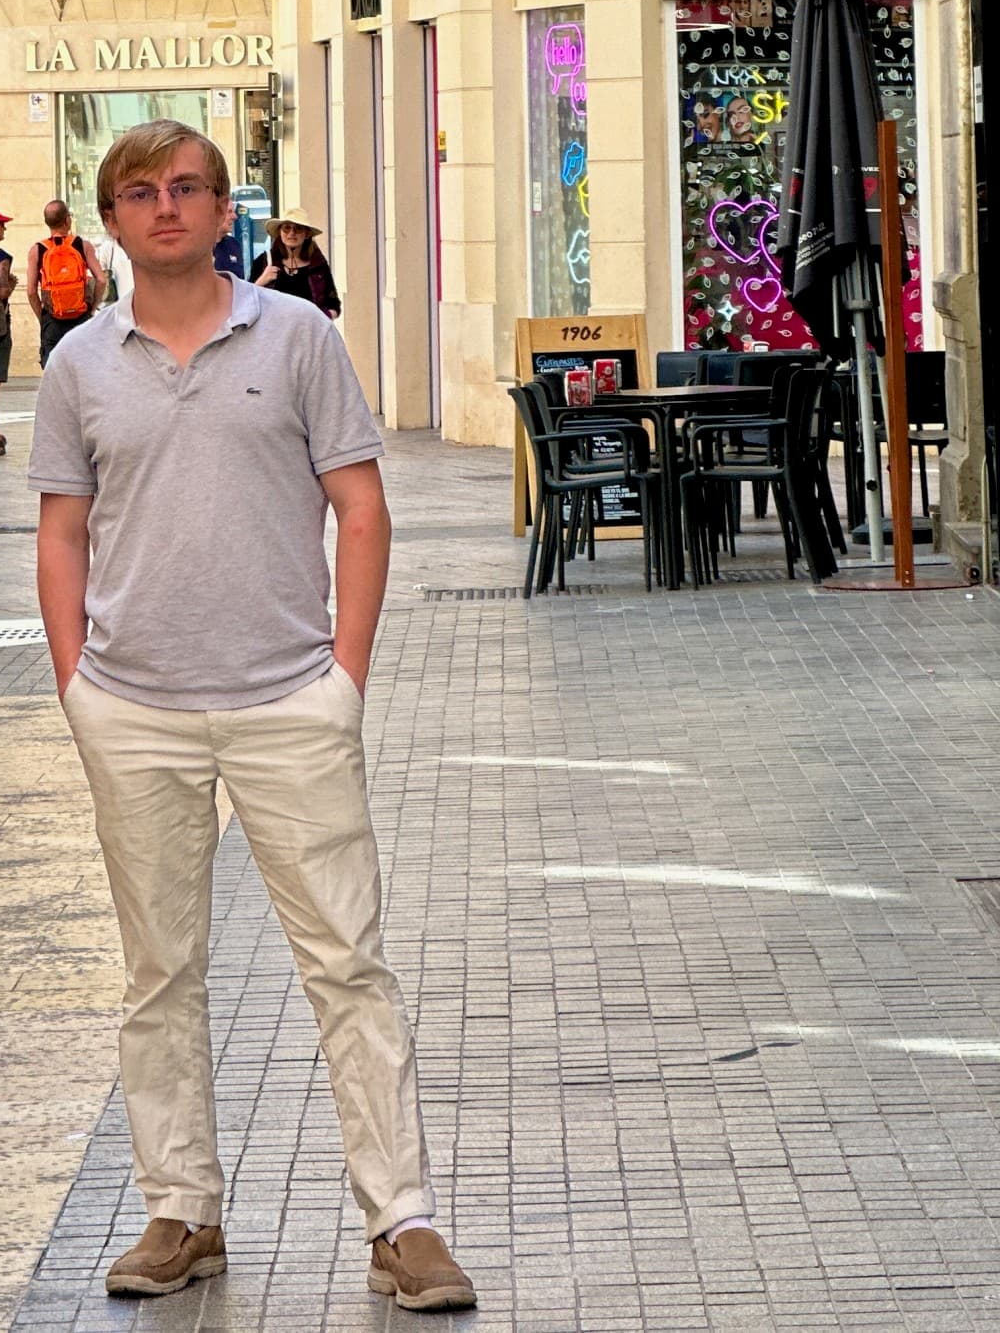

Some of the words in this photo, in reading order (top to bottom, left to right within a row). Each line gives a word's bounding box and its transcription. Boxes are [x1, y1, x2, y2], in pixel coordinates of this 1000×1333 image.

[25, 39, 77, 72] LA
[552, 37, 577, 66] hello
[561, 325, 603, 341] 1906
